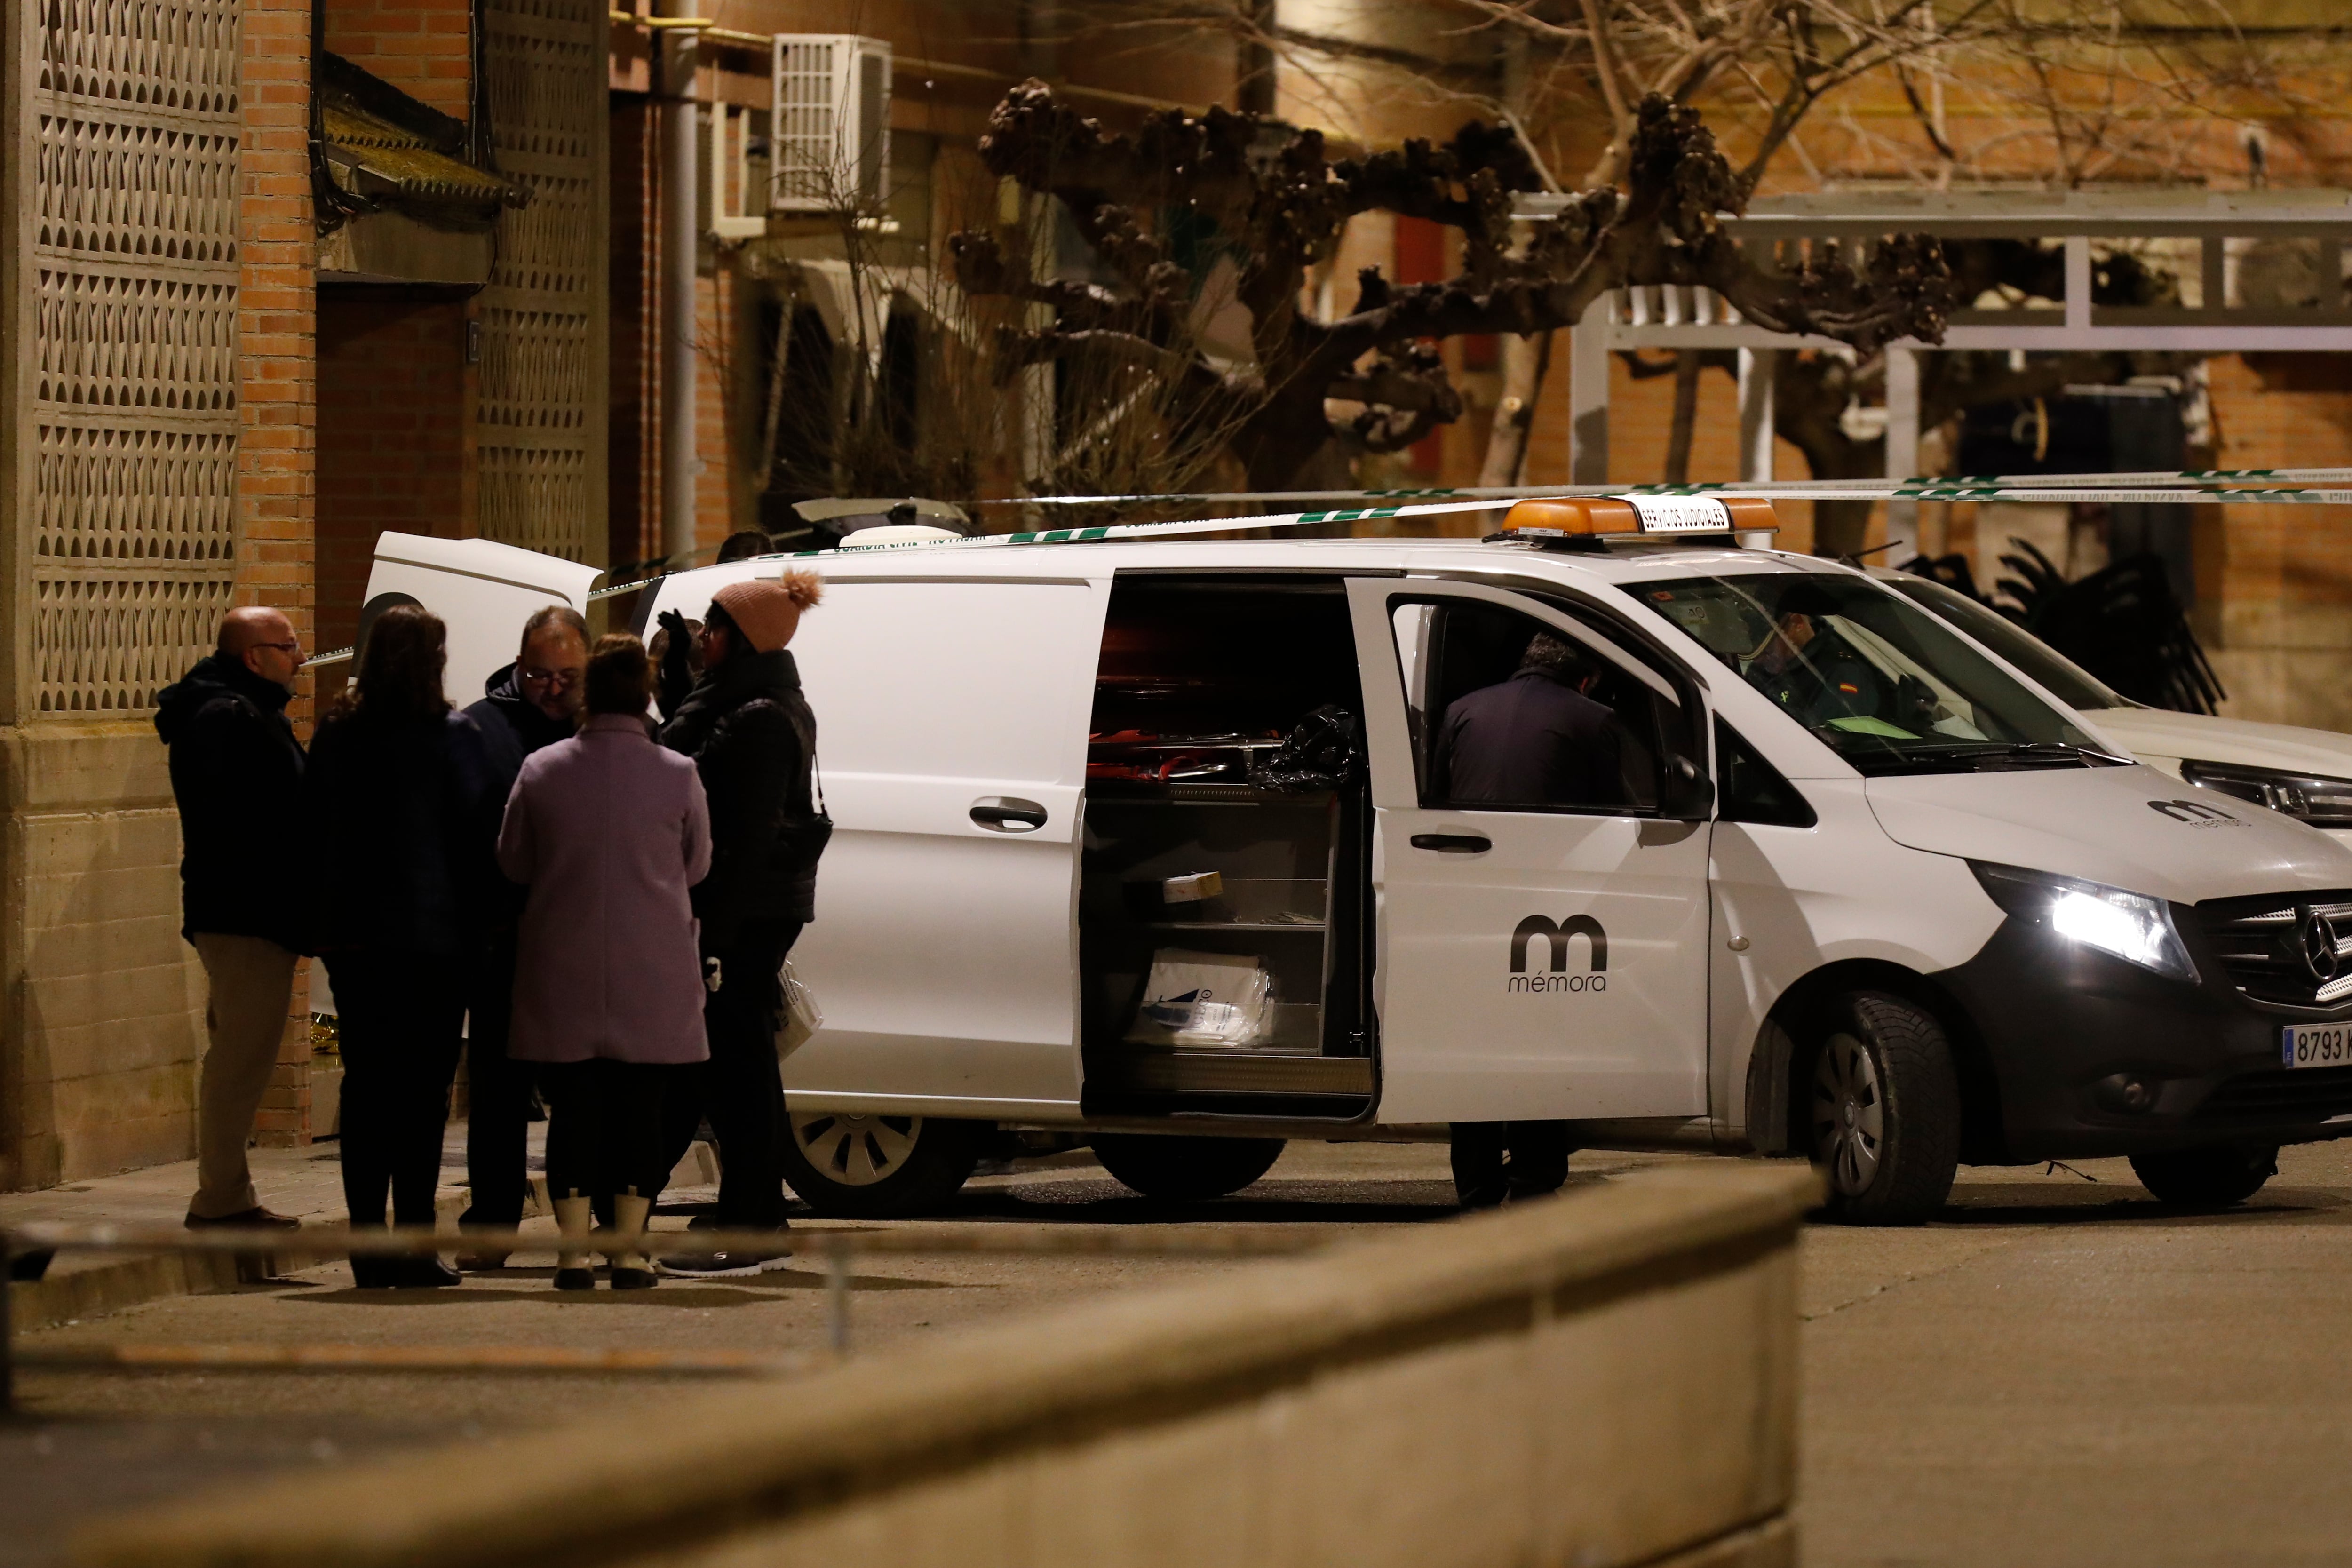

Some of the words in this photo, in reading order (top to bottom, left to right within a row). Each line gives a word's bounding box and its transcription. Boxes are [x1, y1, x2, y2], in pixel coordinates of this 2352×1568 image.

[1642, 508, 1682, 528] SERVICIOS
[1682, 506, 1724, 527] JUDICIALES
[1508, 970, 1606, 992] mémora
[2298, 1030, 2341, 1062] 8793
